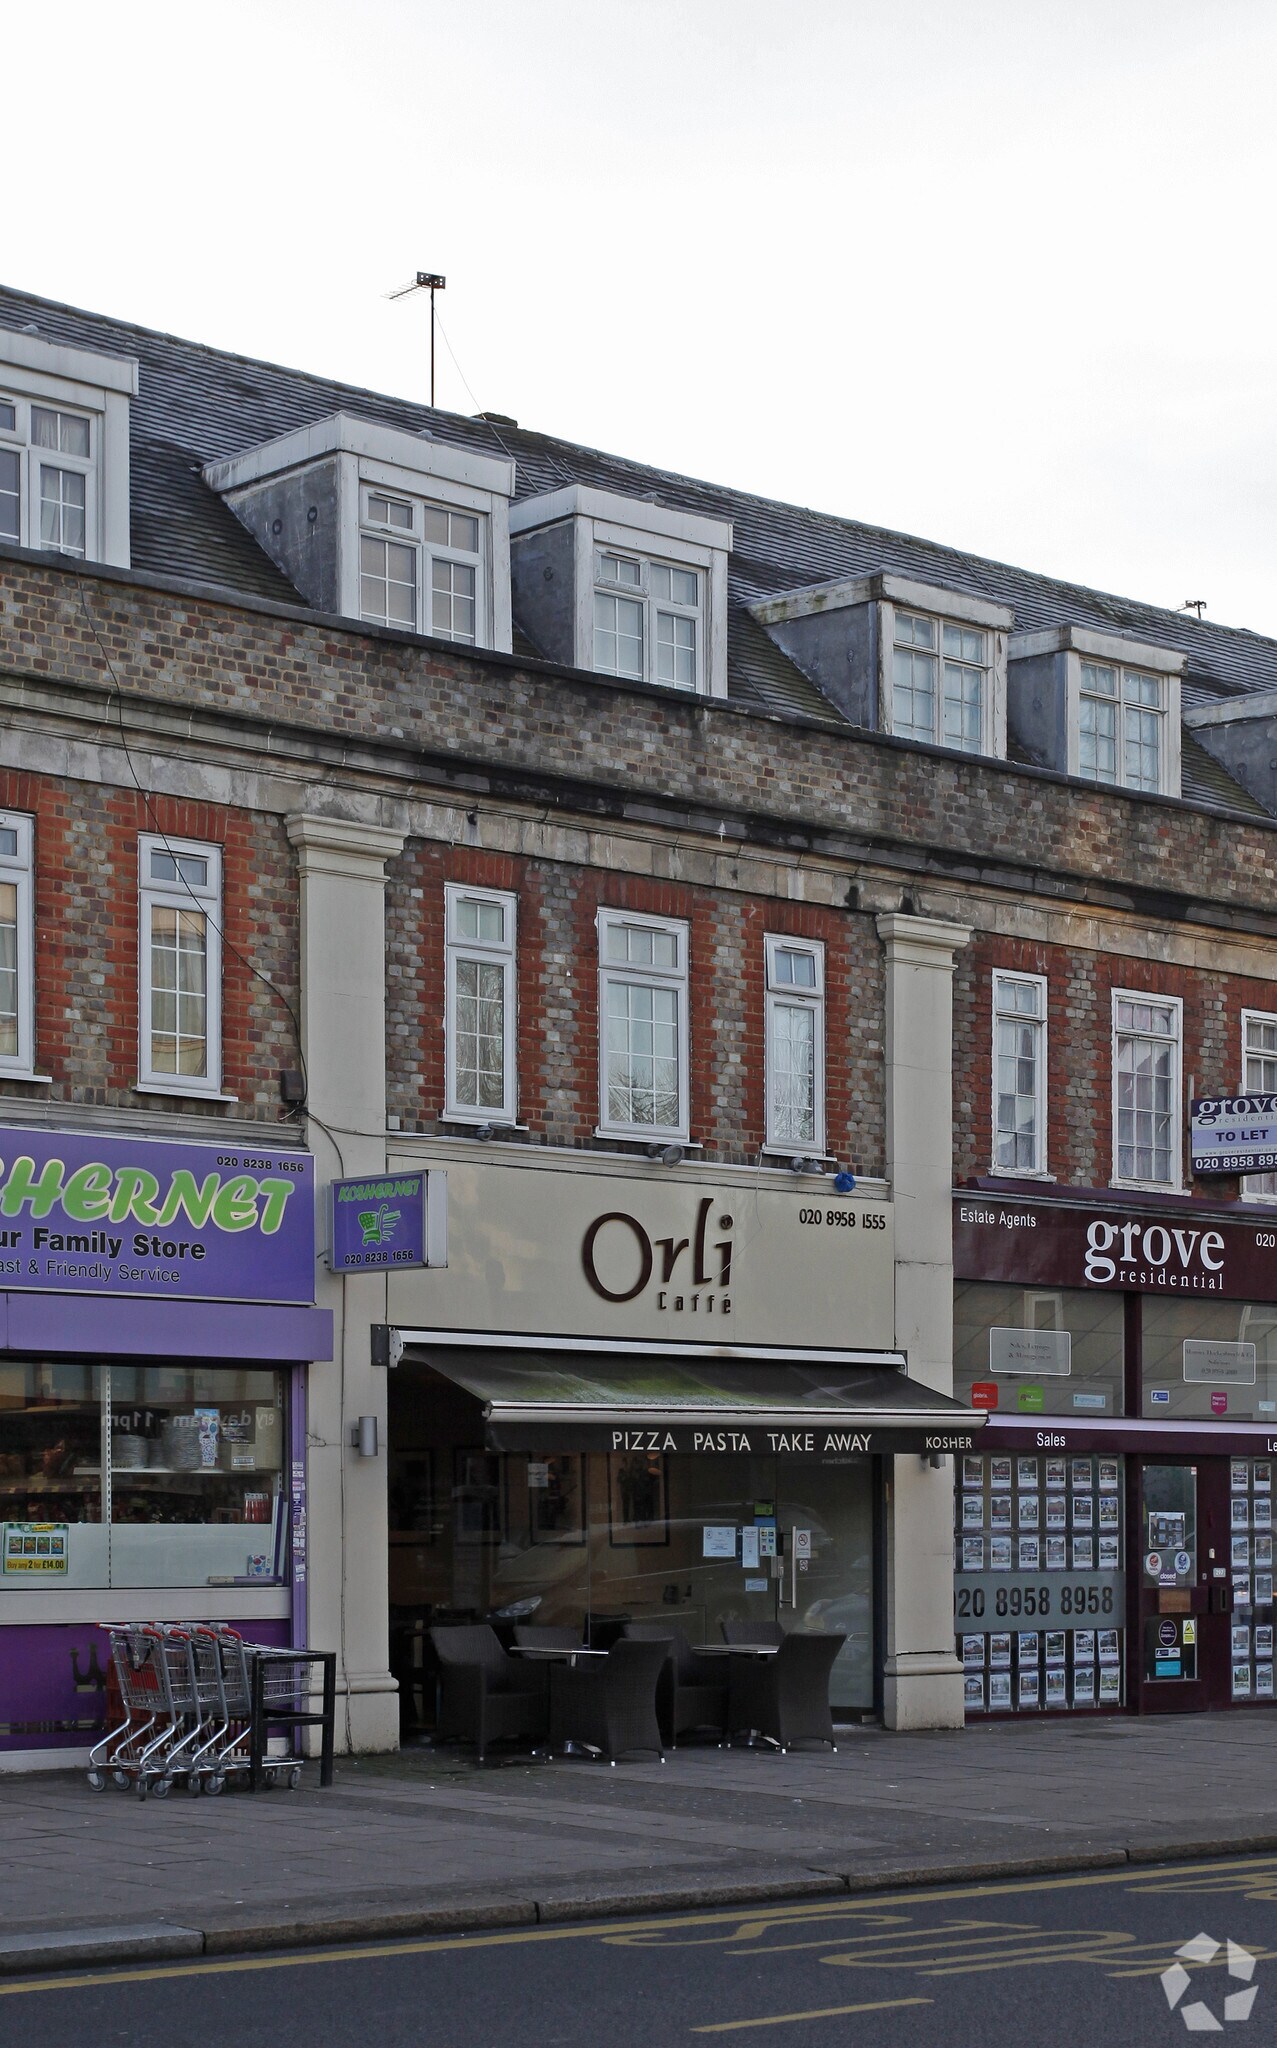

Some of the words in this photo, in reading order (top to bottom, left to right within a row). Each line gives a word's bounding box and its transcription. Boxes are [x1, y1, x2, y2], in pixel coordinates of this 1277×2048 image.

[1216, 1131, 1236, 1142] TO
[1241, 1129, 1269, 1141] LET
[217, 1156, 238, 1167] 020
[243, 1157, 272, 1170] 8238
[278, 1162, 304, 1173] 1656
[1195, 1158, 1219, 1169] 020
[1223, 1155, 1254, 1168] 8958
[0, 1155, 295, 1235] HERNET
[338, 1180, 420, 1202] KOSHERNET
[799, 1208, 822, 1225] 020
[826, 1210, 856, 1228] 8958
[862, 1213, 886, 1230] 1555
[960, 1208, 995, 1224] Estate
[999, 1211, 1037, 1229] Agents
[33, 1228, 122, 1259] Family
[133, 1234, 206, 1260] Store
[582, 1198, 733, 1303] Orli
[1084, 1220, 1225, 1283] grove
[1256, 1233, 1276, 1248] 020
[345, 1253, 361, 1265] 020
[365, 1251, 388, 1263] 8238
[392, 1249, 413, 1260] 1656
[28, 1259, 39, 1275] &
[47, 1260, 111, 1283] Friendly
[119, 1264, 180, 1283] Service
[1119, 1267, 1224, 1290] residential
[658, 1291, 731, 1314] Caffé
[612, 1431, 676, 1451] PIZZA
[694, 1432, 751, 1451] PASTA
[767, 1433, 814, 1451] TAKE
[824, 1434, 872, 1451] AWAY
[926, 1436, 973, 1450] KOSHER
[1036, 1432, 1066, 1447] Sales
[28, 1560, 33, 1569] 2
[42, 1560, 64, 1569] £14.00
[954, 1587, 985, 1618] 20
[996, 1587, 1050, 1617] 8958
[1060, 1586, 1113, 1615] 8958
